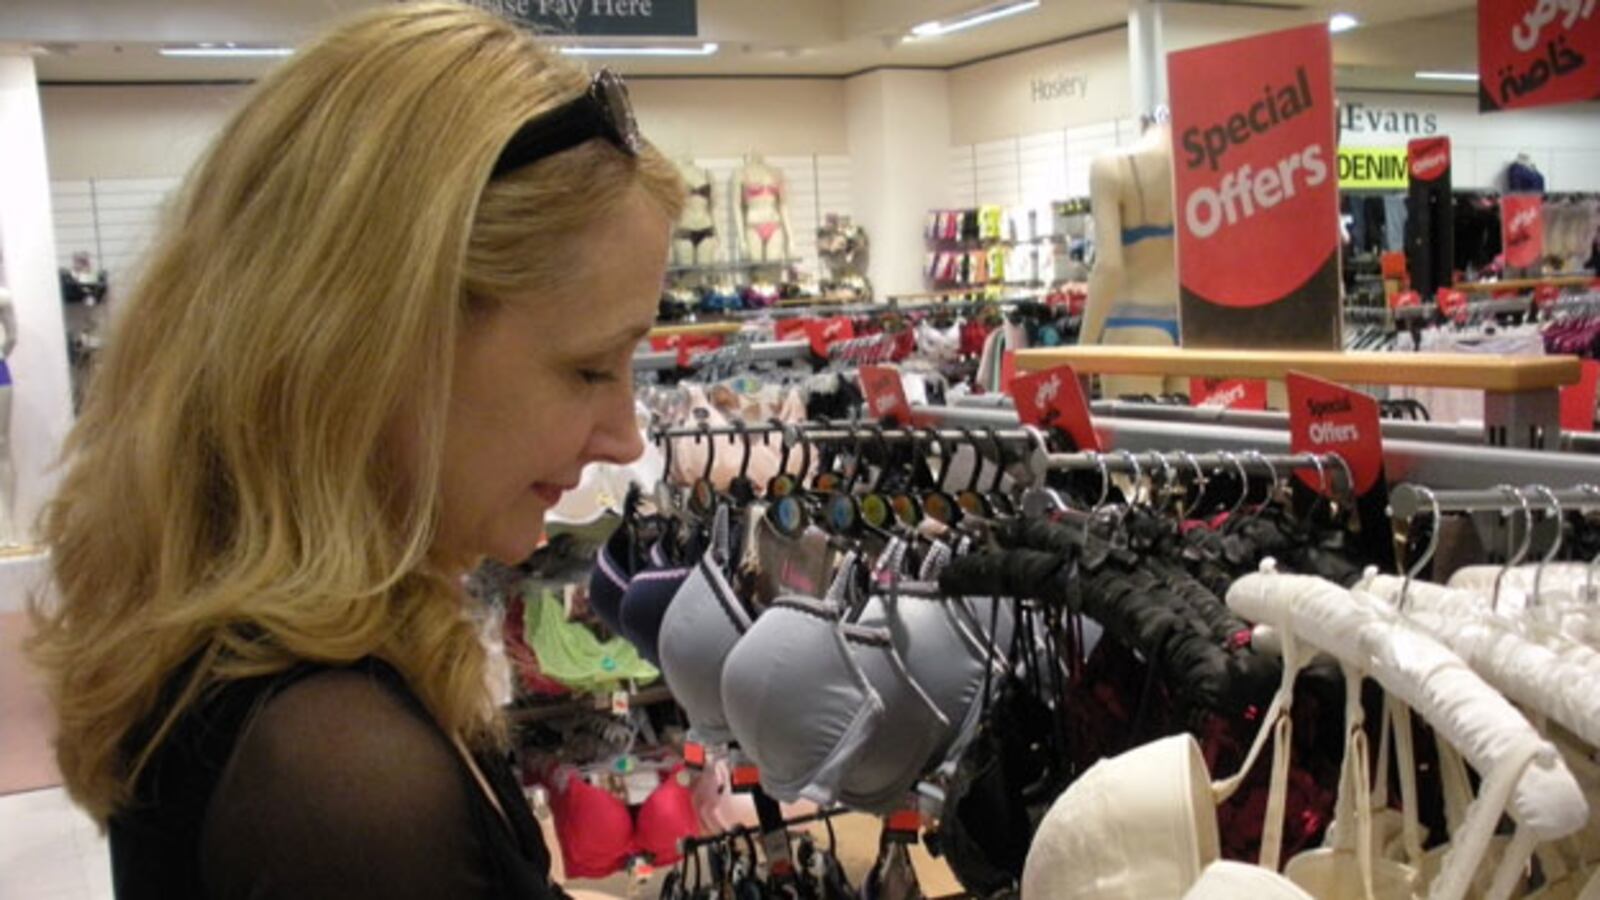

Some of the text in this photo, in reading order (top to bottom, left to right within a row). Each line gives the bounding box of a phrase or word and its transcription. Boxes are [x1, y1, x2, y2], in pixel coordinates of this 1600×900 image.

[590, 0, 652, 17] Here
[1030, 76, 1088, 102] Hosiery
[1182, 65, 1313, 172] Special
[1337, 153, 1408, 181] DENIM
[1185, 143, 1328, 239] Offers
[1309, 421, 1359, 445] Offers
